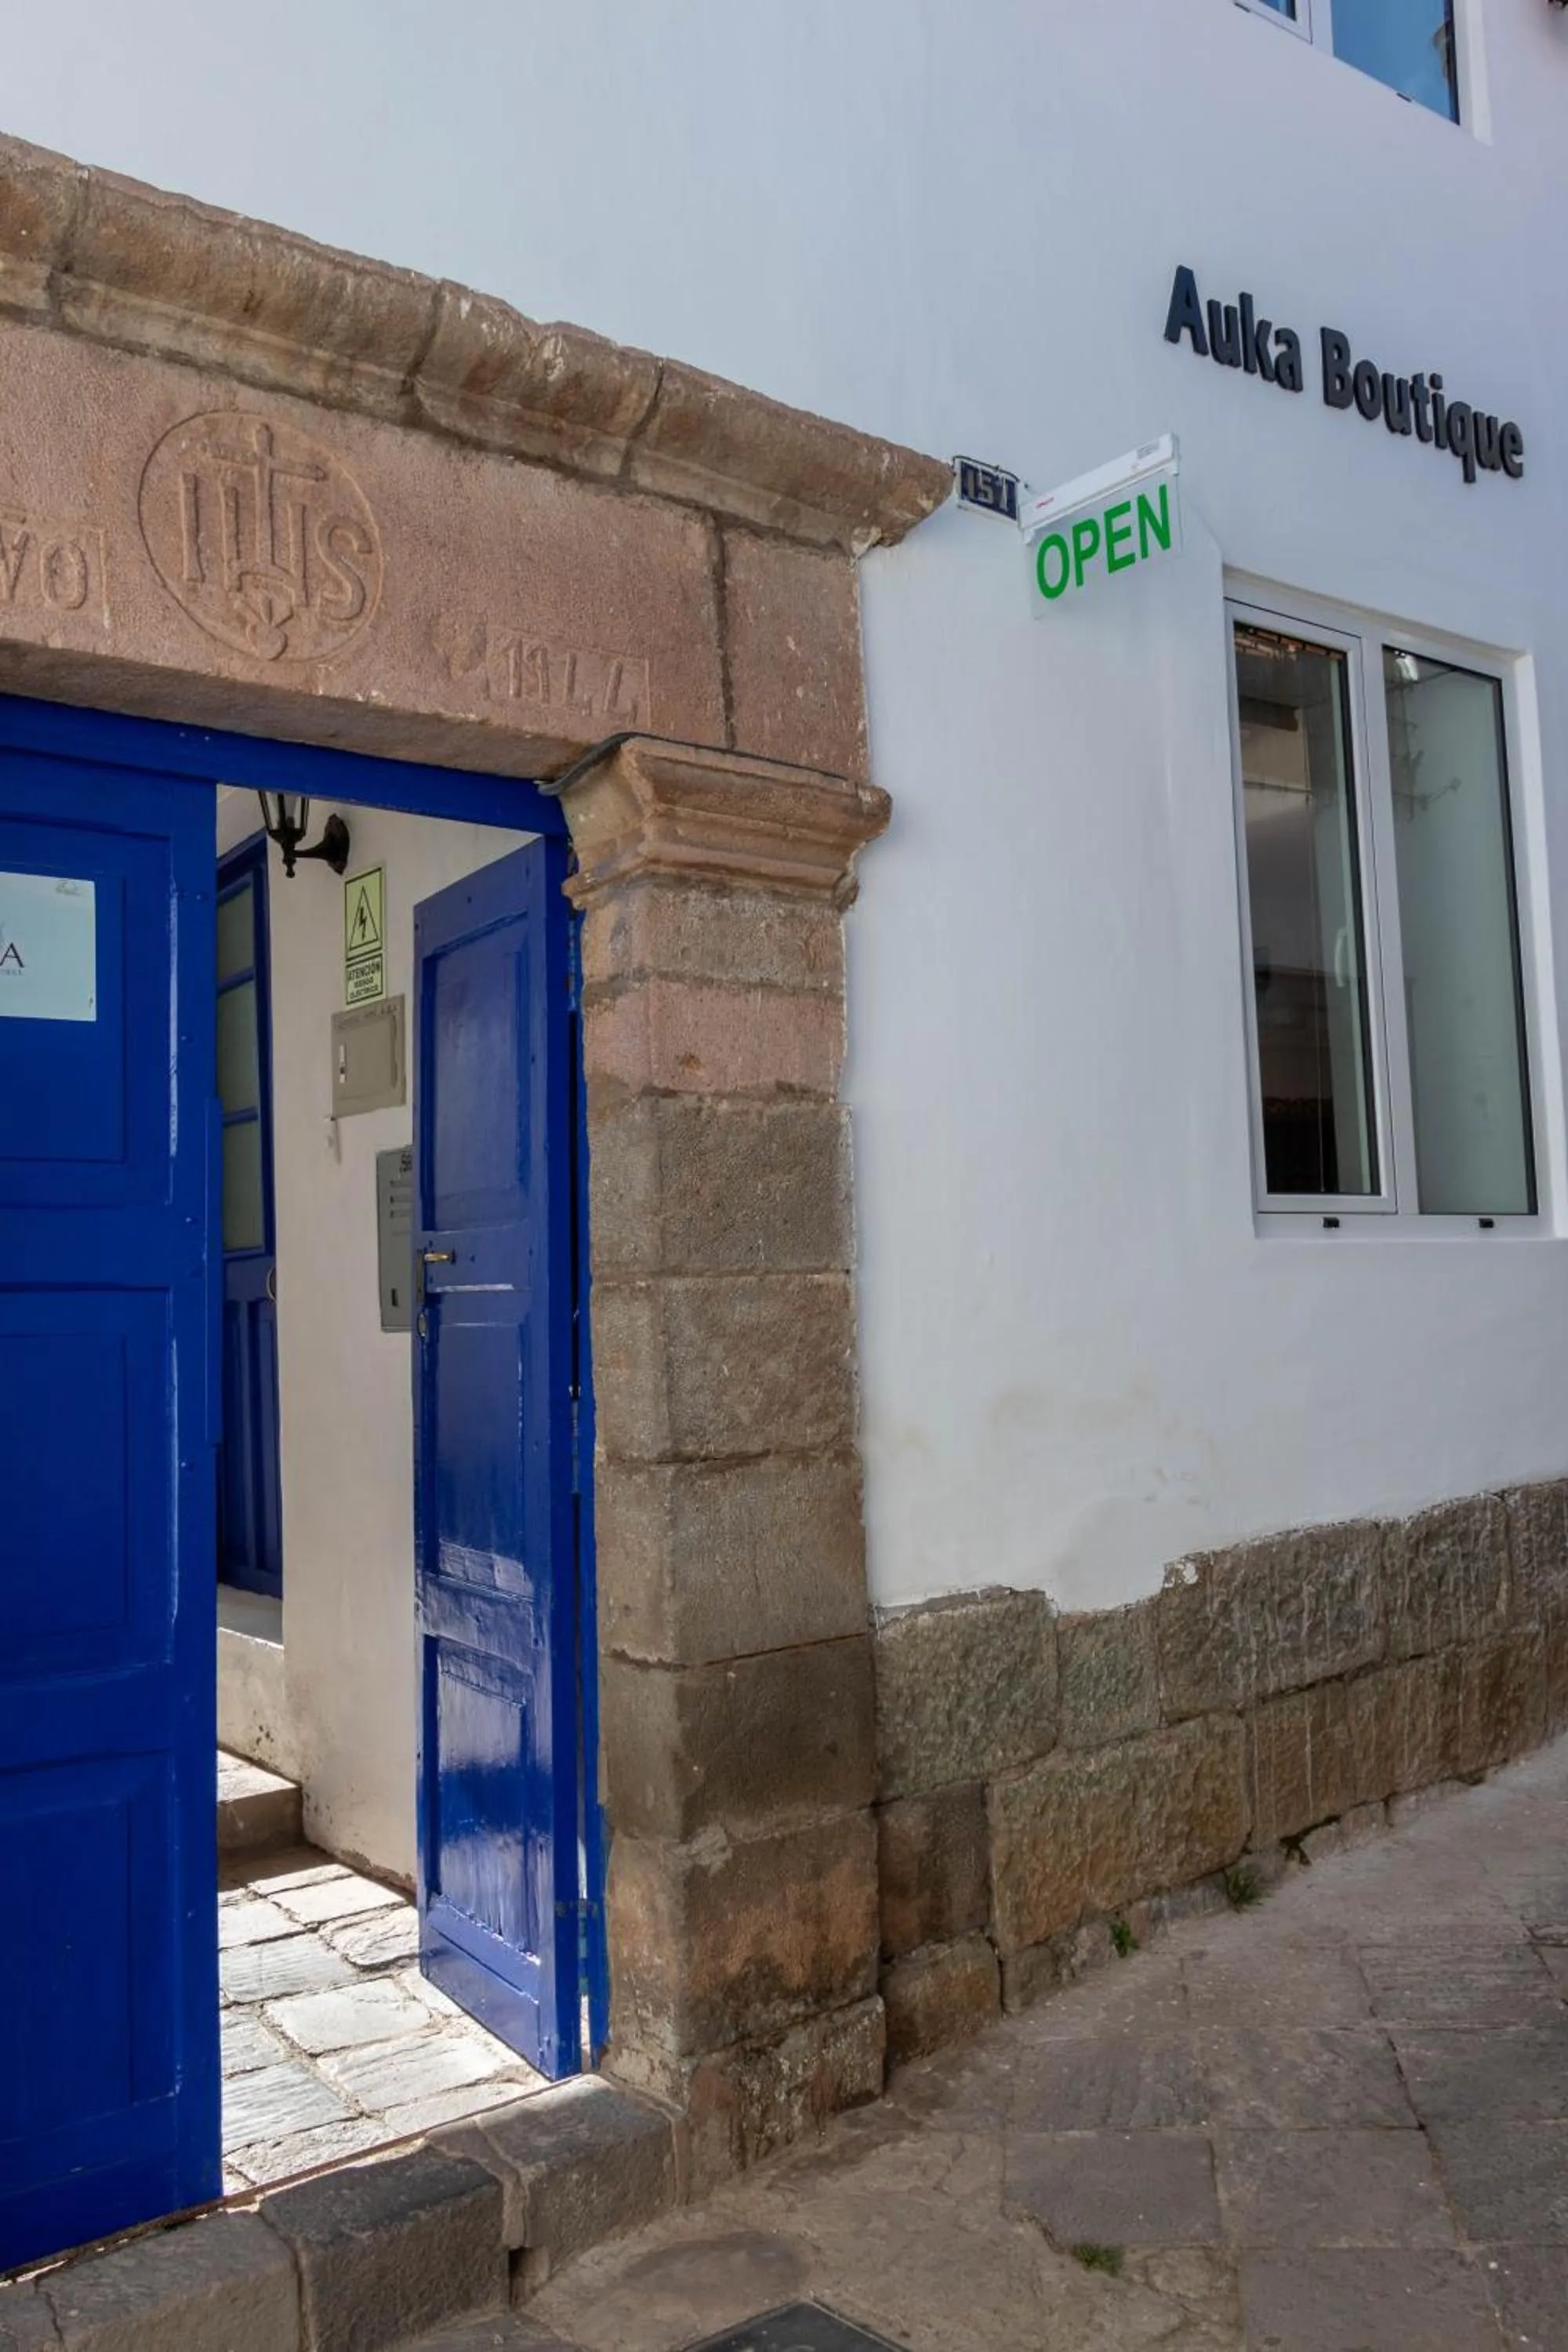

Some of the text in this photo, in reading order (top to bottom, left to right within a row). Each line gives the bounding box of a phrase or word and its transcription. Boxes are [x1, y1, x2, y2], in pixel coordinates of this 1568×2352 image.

[1164, 264, 1524, 484] Auka Boutique
[1036, 483, 1171, 600] OPEN
